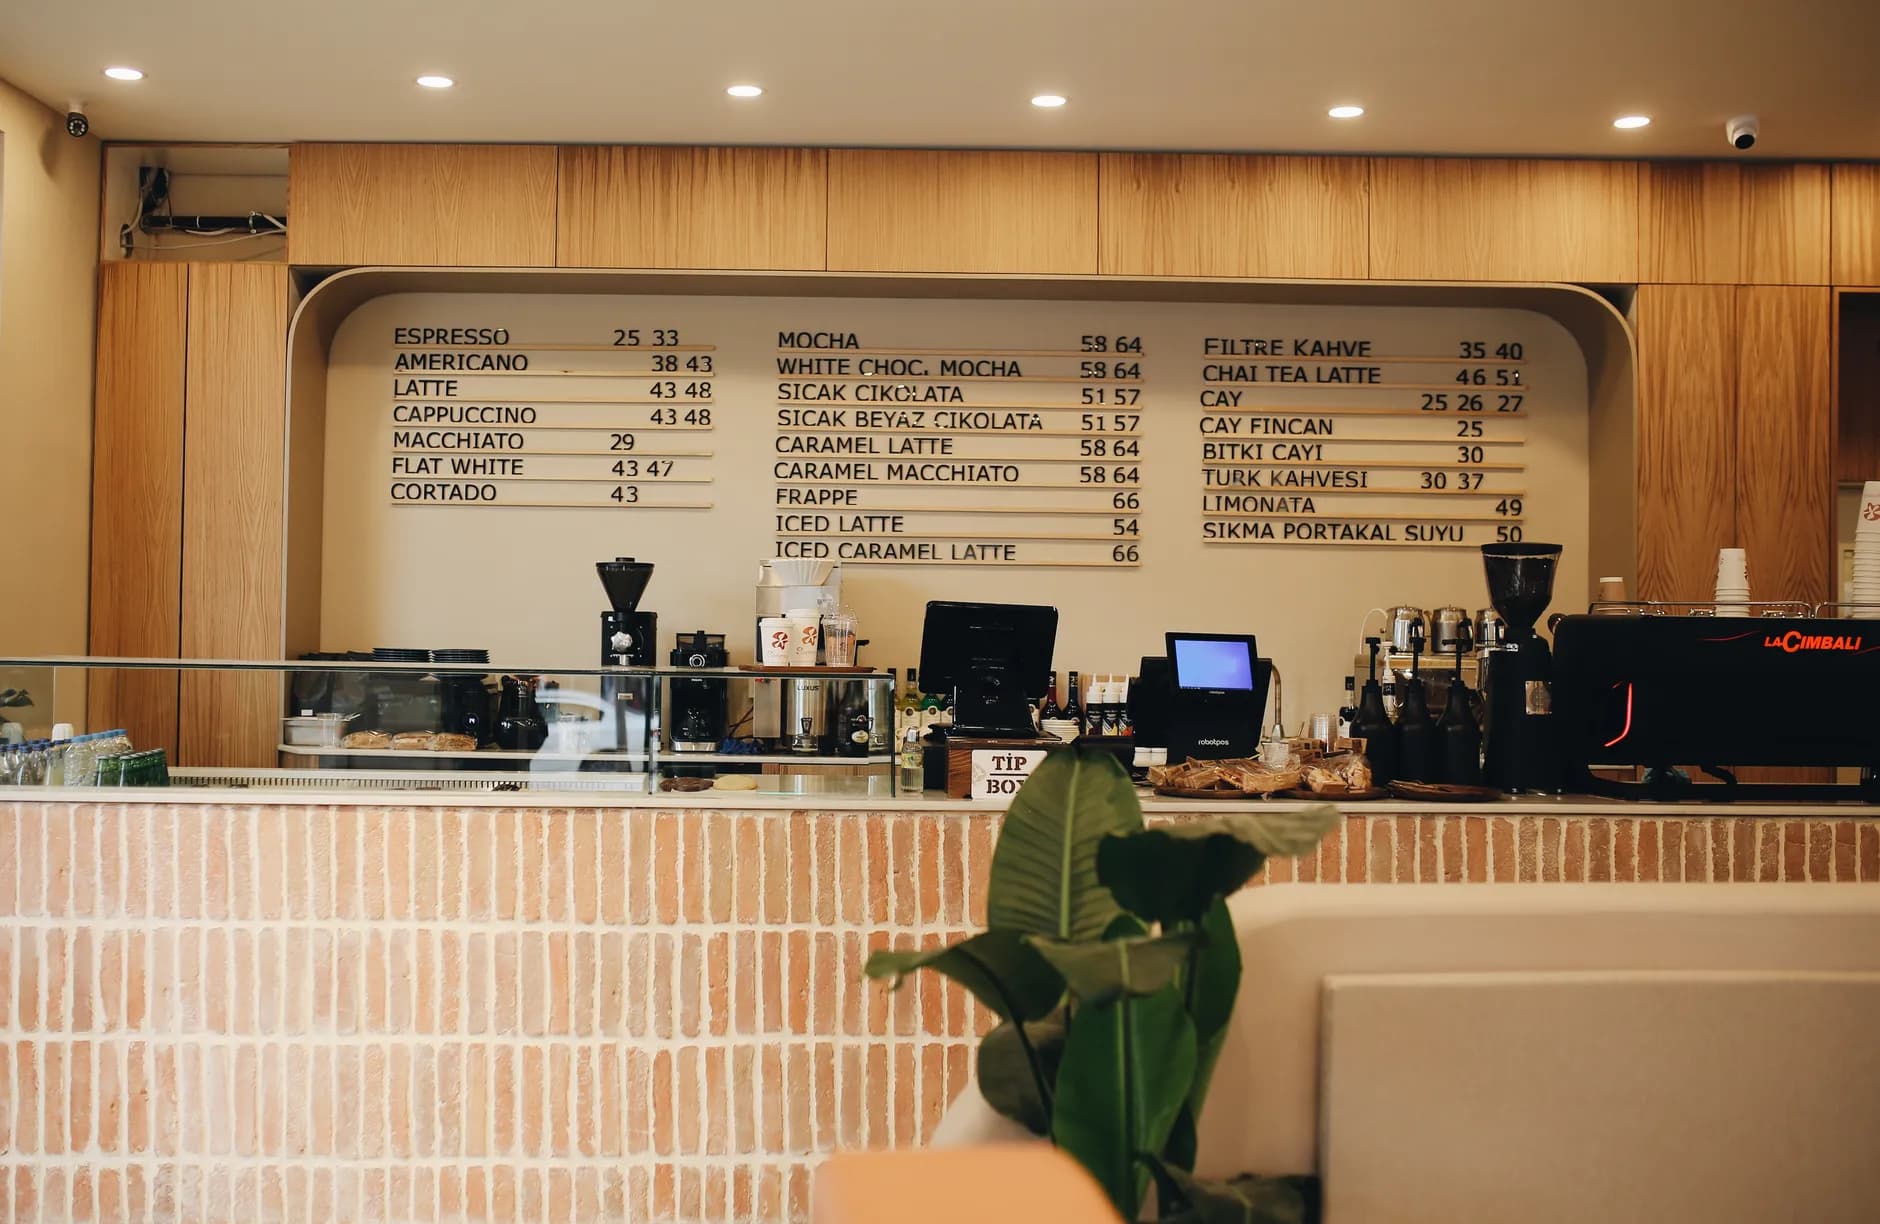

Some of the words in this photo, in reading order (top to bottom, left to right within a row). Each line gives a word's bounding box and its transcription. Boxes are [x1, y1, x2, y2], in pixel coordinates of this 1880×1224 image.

[394, 328, 509, 345] ESPRESSO
[613, 330, 640, 346] 25
[653, 330, 679, 346] 33
[778, 332, 859, 349] MOCHA
[1081, 336, 1107, 352] 58
[1115, 336, 1142, 353] 64
[1205, 339, 1283, 356] FILTRE
[1295, 340, 1371, 357] KAHVE
[1459, 342, 1485, 359] 35
[1496, 343, 1522, 360] 40
[395, 354, 528, 370] AMERICANO
[652, 355, 678, 372] 38
[686, 356, 713, 372] 43
[777, 358, 850, 375] WHITE
[859, 359, 928, 376] CHOC.
[941, 360, 1021, 377] MOCHA
[1080, 362, 1106, 378] 58
[1114, 362, 1141, 379] 64
[1203, 365, 1257, 382] CHAI
[1266, 366, 1307, 382] TEA
[1317, 367, 1381, 384] LATTE
[1456, 369, 1486, 386] 46
[1497, 369, 1523, 386] 51
[394, 380, 457, 396] LATTE
[650, 382, 676, 398] 43
[685, 382, 711, 398] 48
[778, 383, 845, 401] SICAK
[855, 385, 963, 402] CIKOLATA
[1082, 388, 1105, 405] 51
[1114, 389, 1140, 405] 57
[1200, 390, 1242, 407] CAY
[1421, 394, 1447, 411] 25
[1457, 394, 1483, 411] 26
[1498, 395, 1523, 412] 27
[393, 406, 536, 423] CAPPUCCINO
[651, 409, 676, 424] 43
[685, 409, 711, 425] 48
[778, 410, 845, 427] SICAK
[856, 411, 924, 428] BEYAZ
[934, 412, 1042, 429] CIKOLATA
[1082, 415, 1105, 431] 51
[1114, 415, 1140, 432] 57
[1200, 417, 1242, 433] CAY
[1251, 418, 1333, 434] FINCAN
[1457, 420, 1483, 437] 25
[394, 432, 524, 448] MACCHIATO
[611, 434, 634, 450] 29
[776, 436, 879, 453] CARAMEL
[889, 438, 952, 454] LATTE
[1081, 439, 1106, 456] 58
[1113, 440, 1139, 456] 64
[1203, 443, 1263, 460] BITKI
[1273, 444, 1322, 461] CAYI
[1458, 446, 1483, 463] 30
[393, 458, 442, 474] FLAT
[451, 459, 523, 475] WHITE
[612, 460, 638, 477] 43
[647, 460, 674, 477] 47
[774, 462, 878, 480] CARAMEL
[888, 464, 1019, 481] MACCHIATO
[1080, 466, 1105, 483] 58
[1113, 467, 1139, 483] 64
[1202, 469, 1260, 486] TURK
[1271, 470, 1367, 488] KAHVESI
[1421, 472, 1446, 489] 30
[1458, 473, 1484, 489] 37
[391, 483, 496, 500] CORTADO
[611, 486, 638, 502] 43
[777, 488, 858, 506] FRAPPE
[1113, 492, 1139, 509] 66
[1203, 495, 1315, 513] LIMONATA
[1496, 499, 1522, 516] 49
[777, 515, 829, 532] ICED
[839, 516, 903, 532] LATTE
[1114, 519, 1139, 535] 54
[1203, 522, 1274, 539] SIKMA
[1284, 523, 1396, 540] PORTAKAL
[1405, 525, 1463, 541] SUYU
[1497, 526, 1522, 543] 50
[776, 541, 828, 558] ICED
[838, 543, 942, 560] CARAMEL
[952, 544, 1016, 561] LATTE
[1113, 545, 1139, 562] 66
[1198, 738, 1229, 746] robotpos
